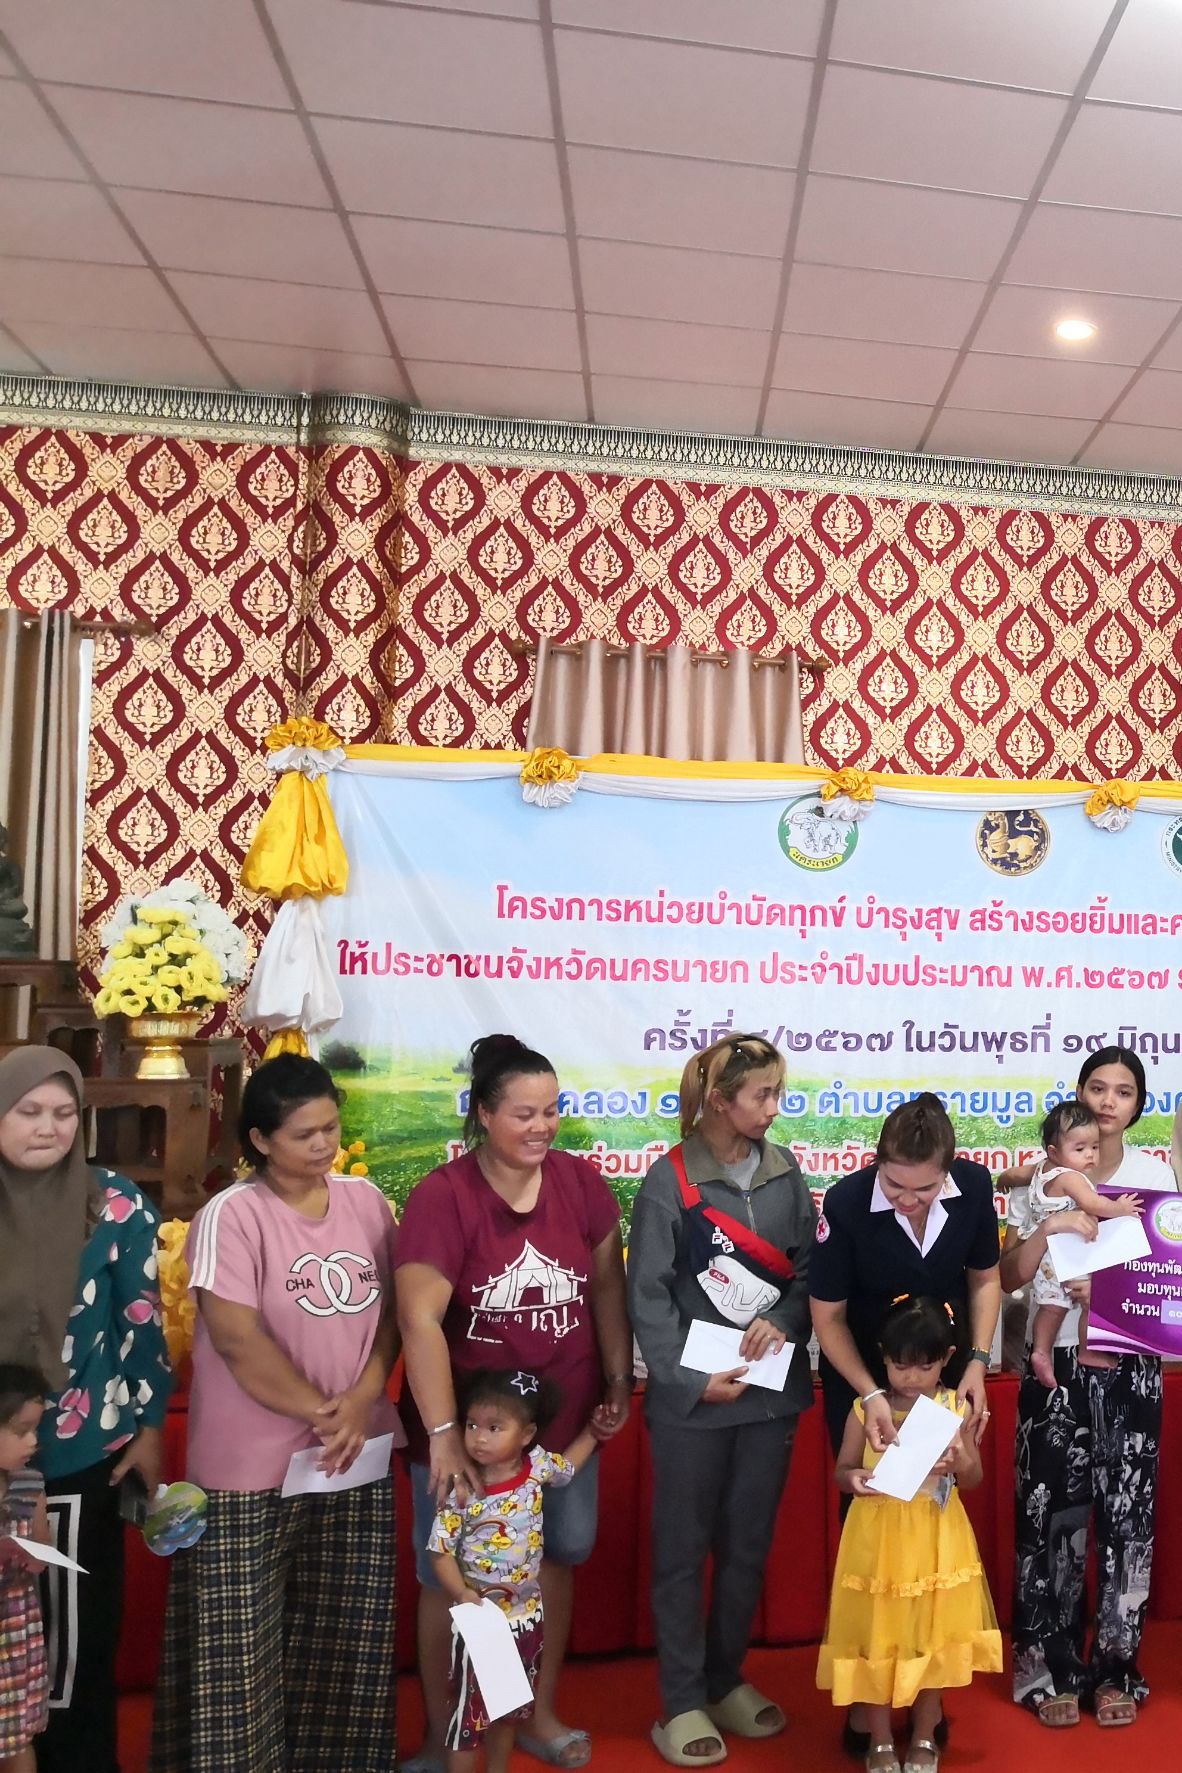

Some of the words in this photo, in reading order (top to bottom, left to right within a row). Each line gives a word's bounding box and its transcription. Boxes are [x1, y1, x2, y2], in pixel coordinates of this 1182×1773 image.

[496, 884, 847, 939] โครงการหน่วยบำบัดทุกข์
[855, 895, 960, 941] บำรุงสุข
[337, 939, 749, 983] ให้ประชาชนจังหวัดนครนายก
[759, 951, 1012, 988] ประจำปีงบประมาณ
[1022, 964, 1169, 990] พ.ศ.๒๕๖๗
[750, 1026, 893, 1052] /๒๕๖๗
[902, 1013, 1051, 1064] ในวันพุธที่
[1063, 1032, 1107, 1053] ๑๙
[285, 1278, 315, 1292] CHA
[1121, 1298, 1160, 1317] จำนวน
